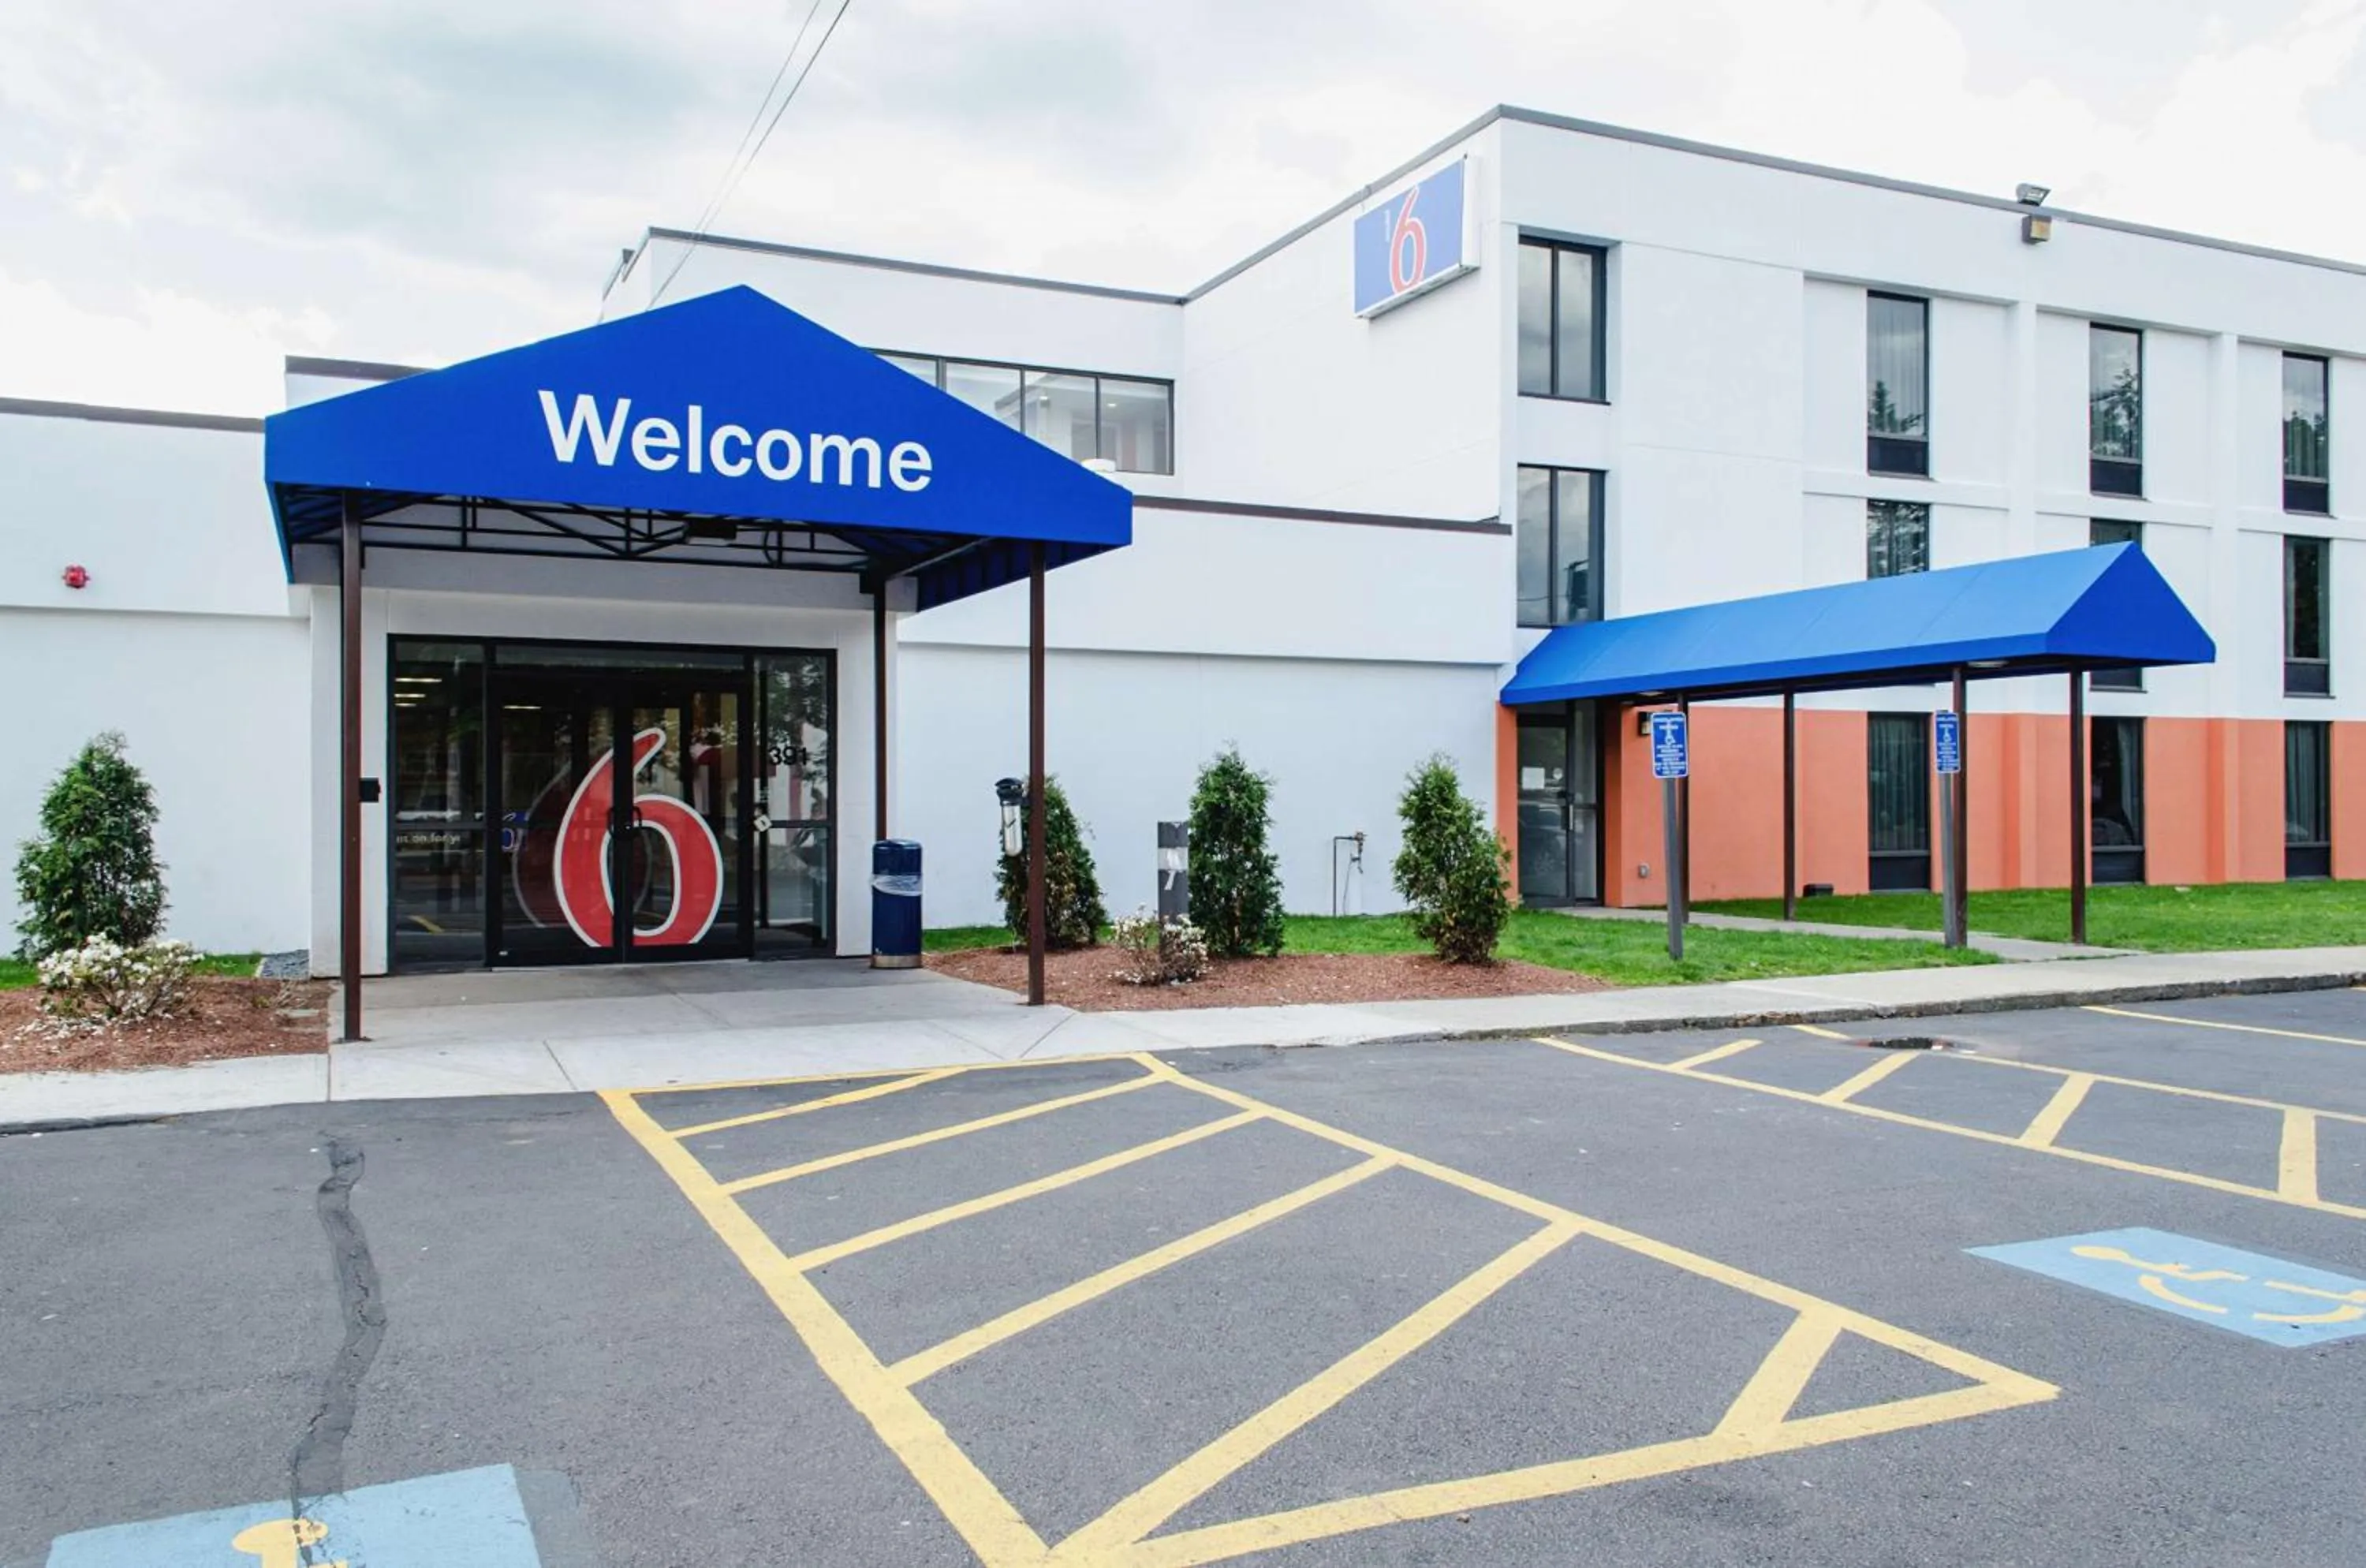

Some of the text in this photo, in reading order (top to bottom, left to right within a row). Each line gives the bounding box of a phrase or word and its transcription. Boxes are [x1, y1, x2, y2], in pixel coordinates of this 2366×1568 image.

[1390, 183, 1427, 295] 6
[538, 390, 932, 492] Welcome
[770, 746, 807, 765] 391
[554, 726, 723, 947] 6
